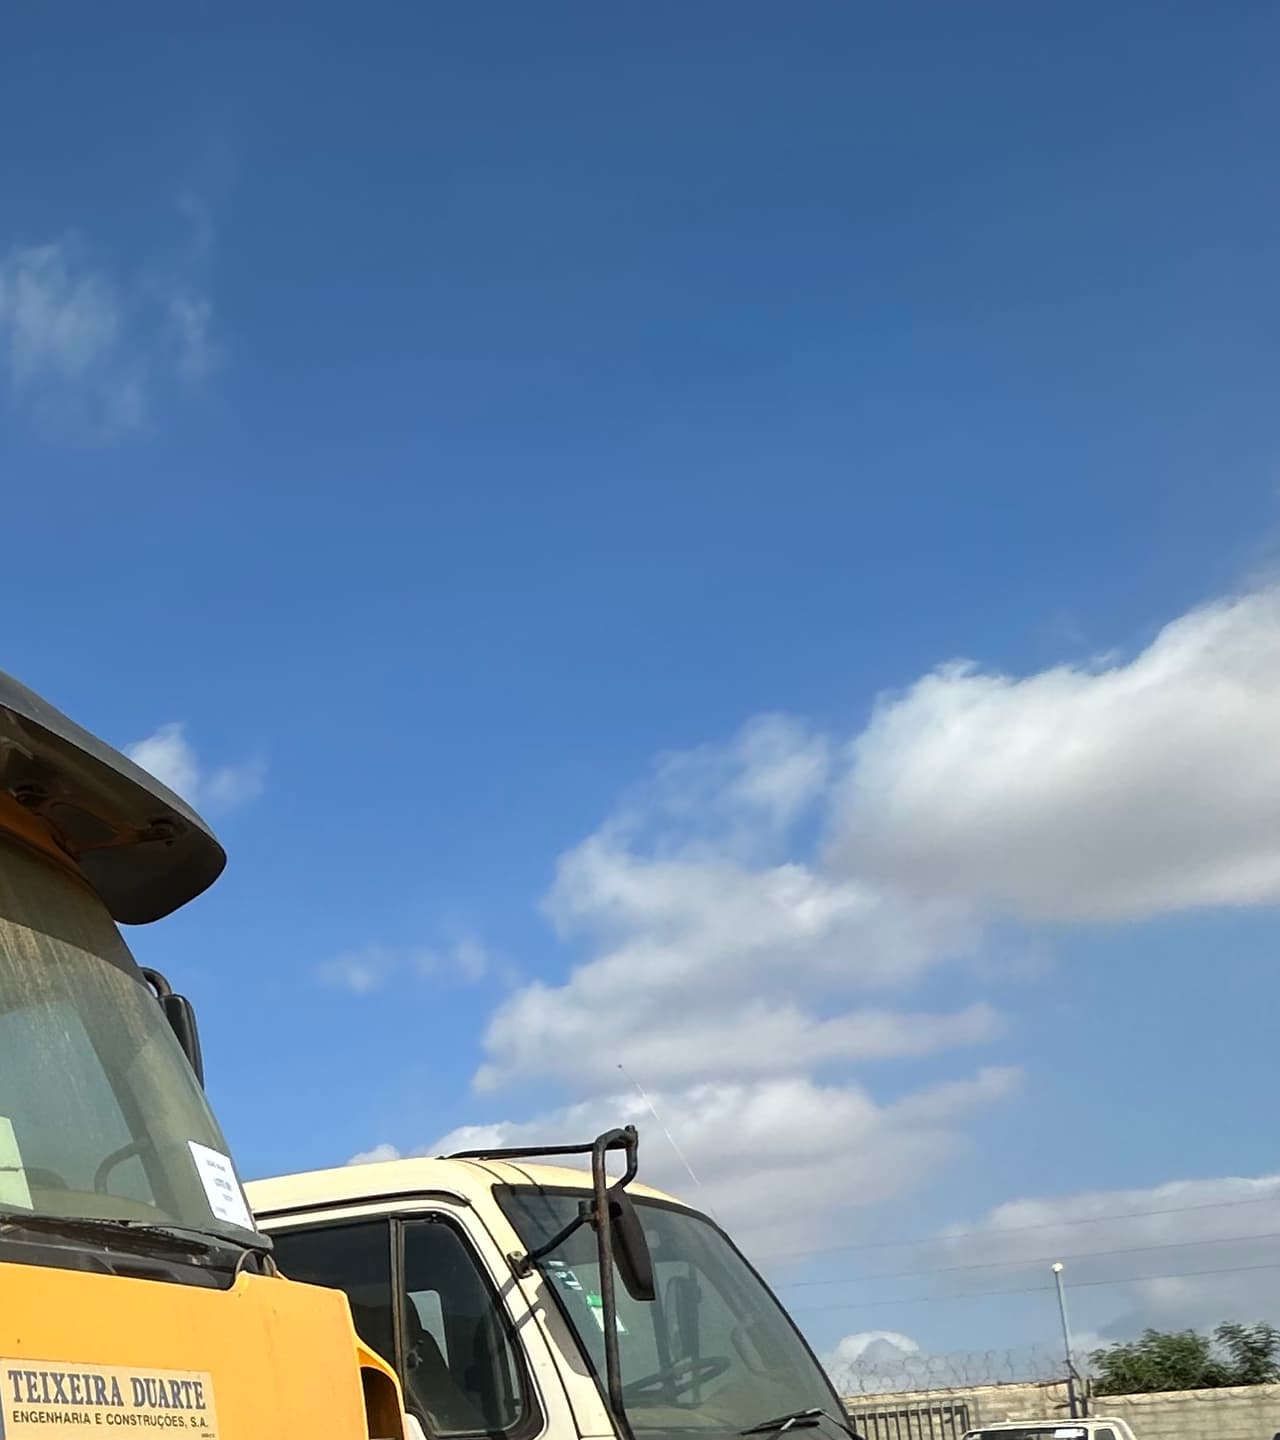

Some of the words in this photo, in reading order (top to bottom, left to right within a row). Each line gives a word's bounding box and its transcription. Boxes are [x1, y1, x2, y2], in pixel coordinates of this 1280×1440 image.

[8, 1370, 125, 1407] TEIXEIRA
[130, 1377, 206, 1409] DUARTE
[12, 1411, 90, 1425] ENGENHARIA
[96, 1413, 102, 1425] E
[190, 1417, 209, 1428] S.A.
